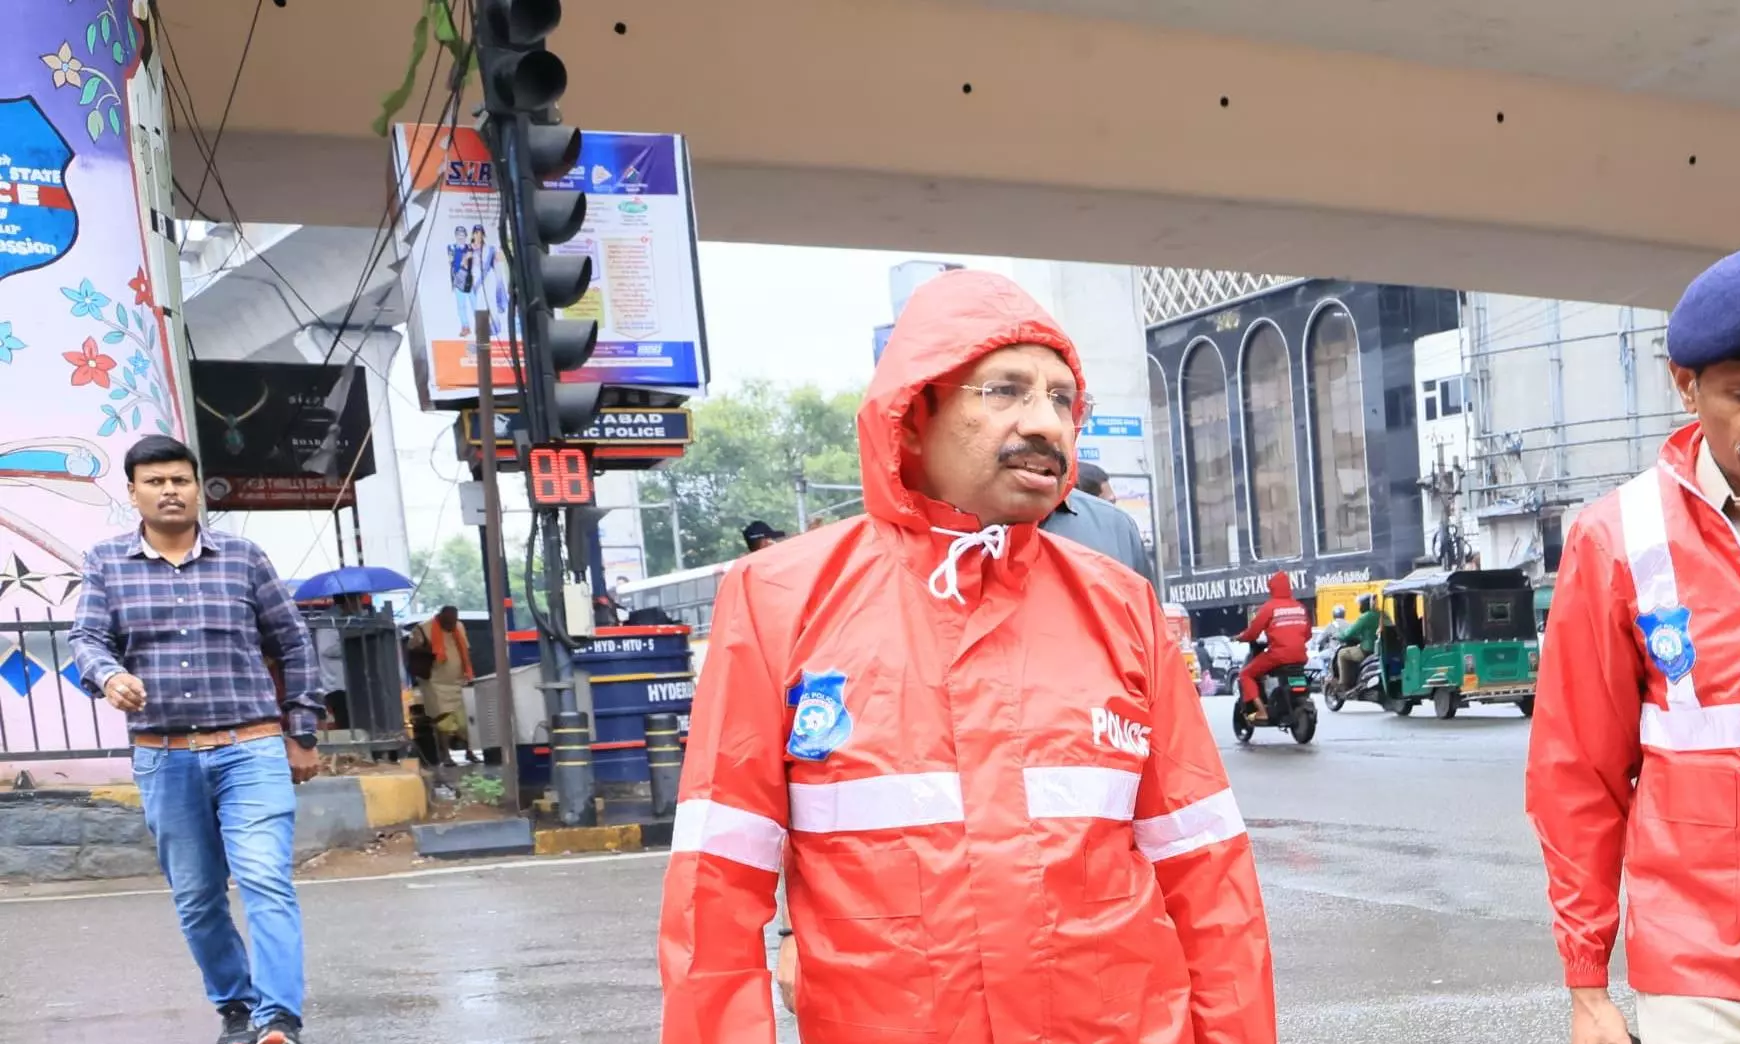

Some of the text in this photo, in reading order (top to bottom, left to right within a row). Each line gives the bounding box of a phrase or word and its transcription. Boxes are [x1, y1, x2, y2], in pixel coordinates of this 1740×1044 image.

[9, 167, 62, 184] STATE
[604, 426, 666, 438] POLICE
[1169, 578, 1226, 603] MERIDIAN
